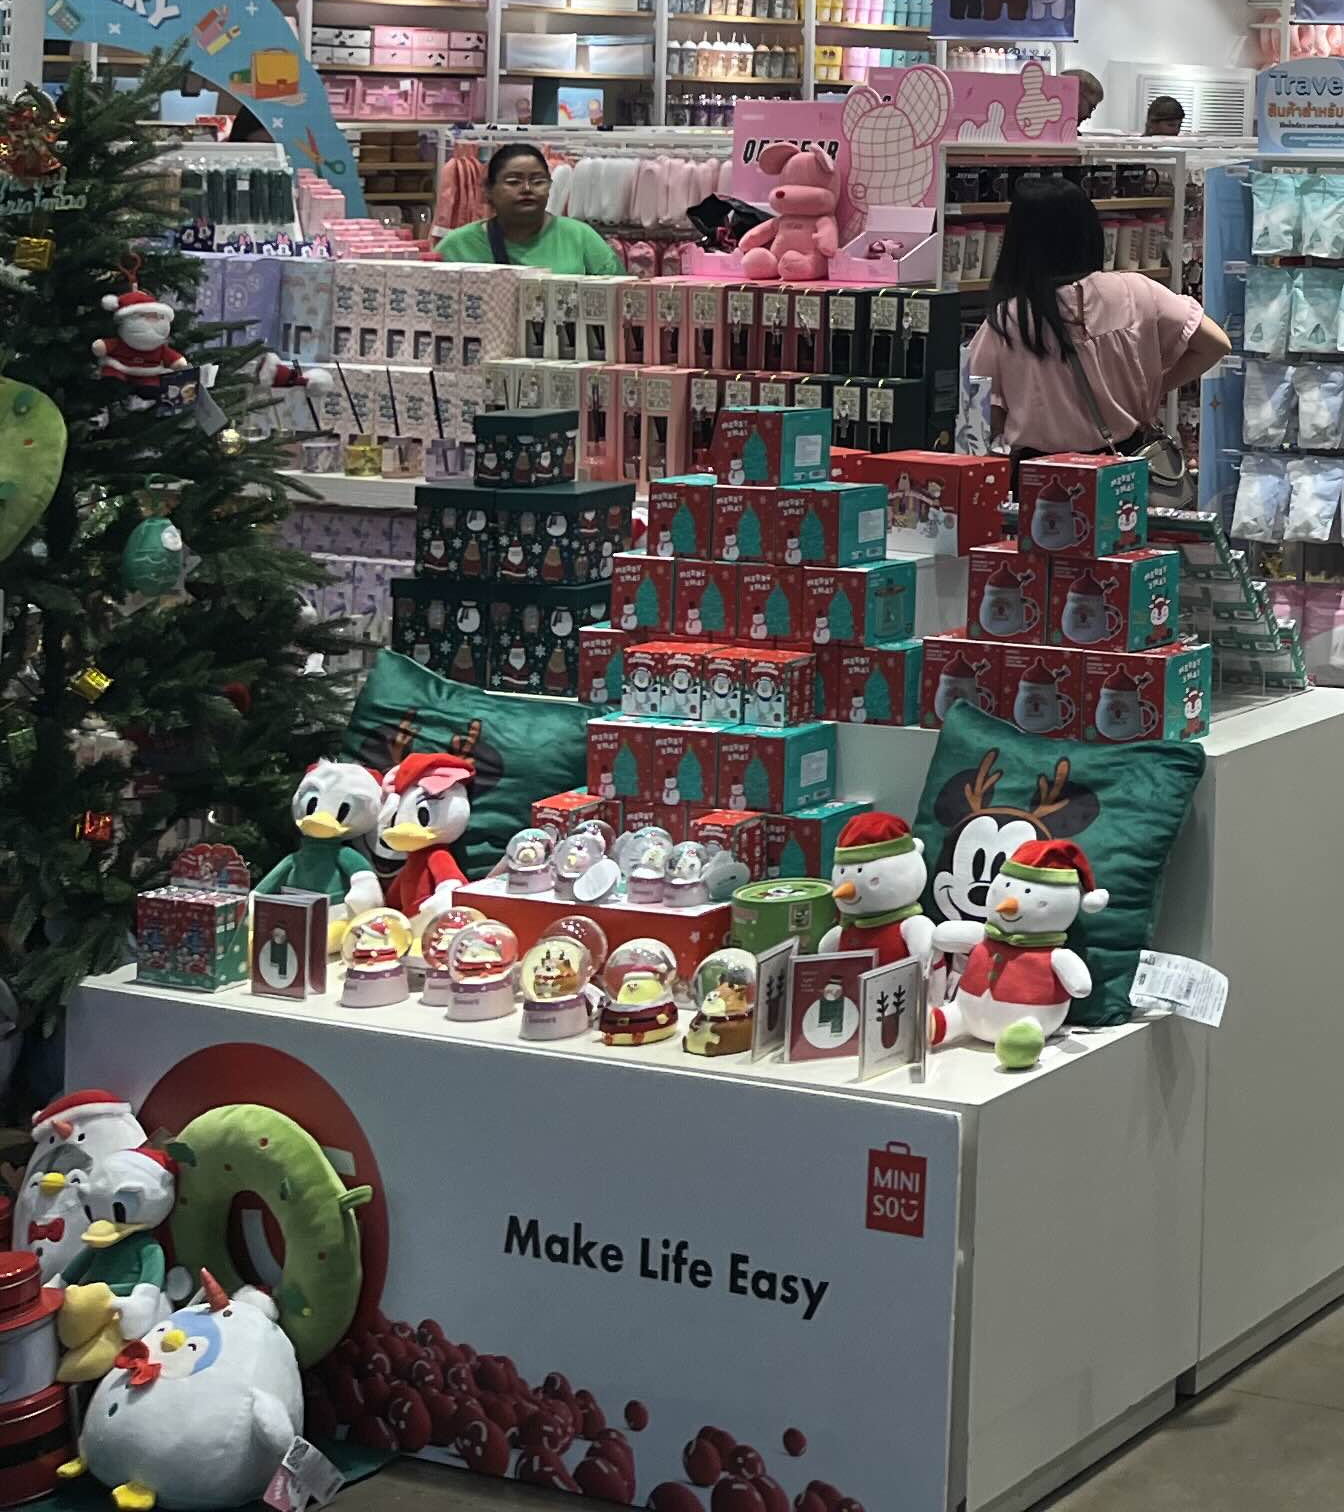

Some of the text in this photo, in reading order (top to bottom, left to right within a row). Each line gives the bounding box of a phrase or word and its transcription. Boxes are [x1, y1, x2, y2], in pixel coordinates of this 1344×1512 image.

[873, 1166, 921, 1194] MINI
[503, 1215, 830, 1321] Make Life Easy
